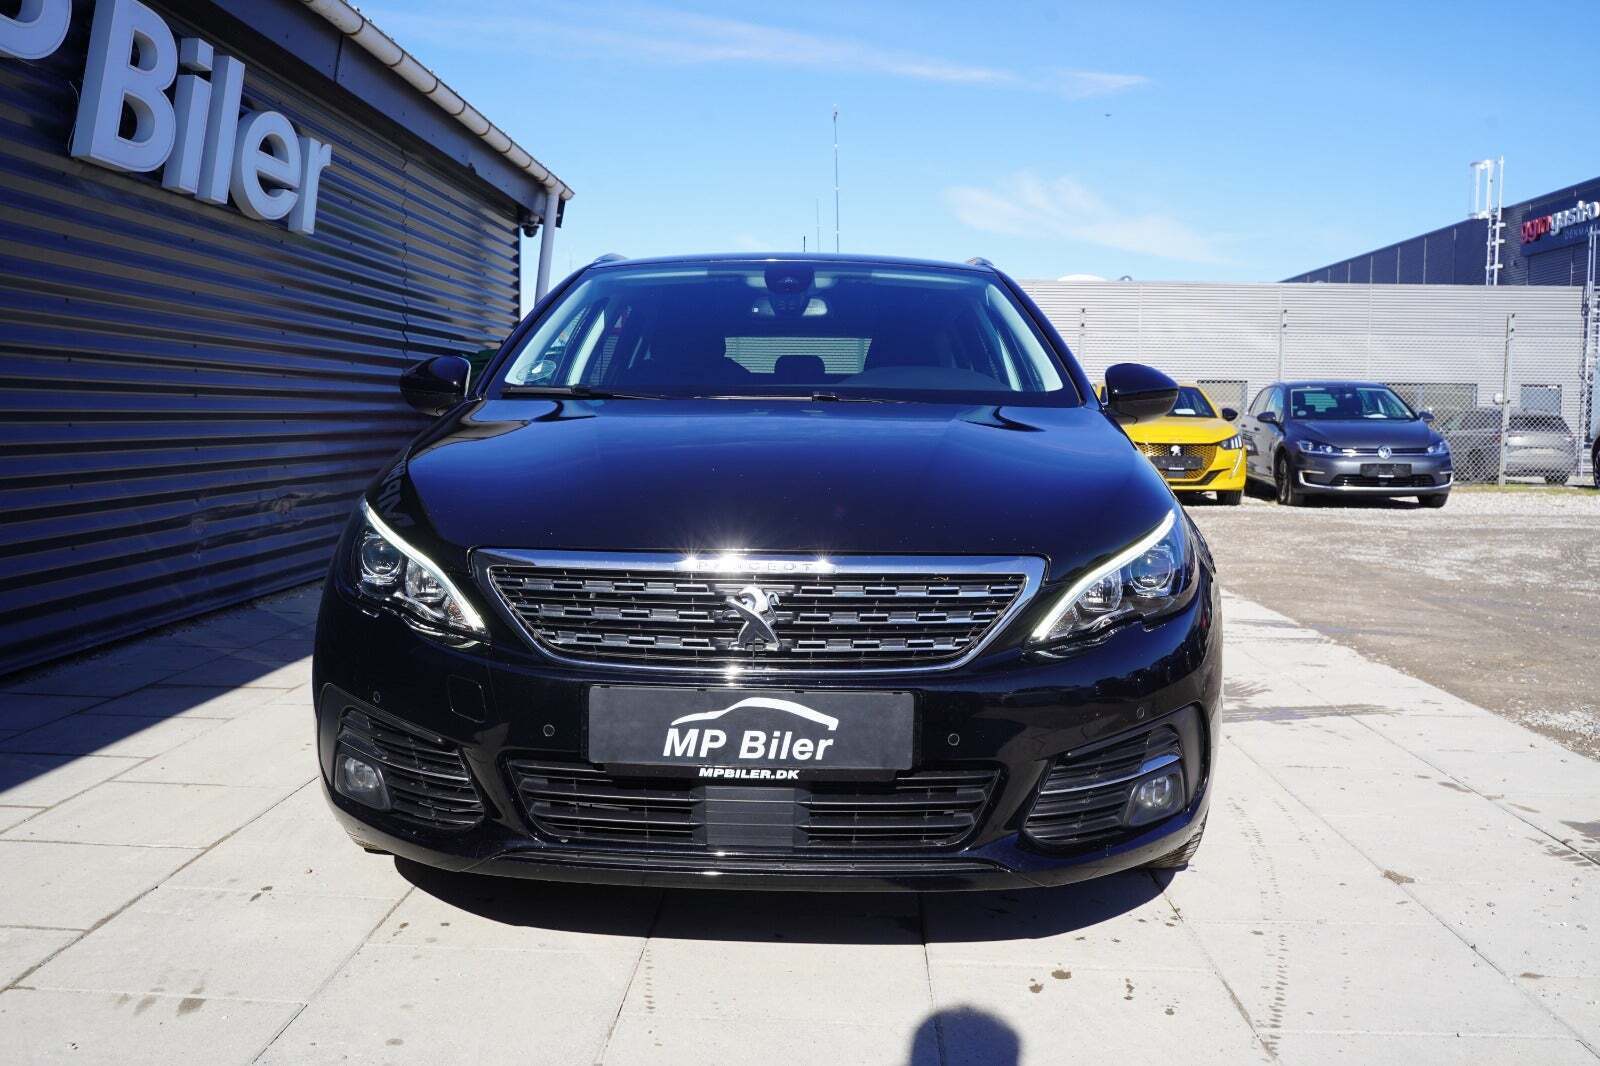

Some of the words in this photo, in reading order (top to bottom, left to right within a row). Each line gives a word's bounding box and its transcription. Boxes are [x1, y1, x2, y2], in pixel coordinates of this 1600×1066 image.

[71, 0, 332, 234] Biler
[662, 728, 727, 758] MP
[738, 730, 834, 761] Biler
[698, 767, 800, 780] MPBILER.DK
